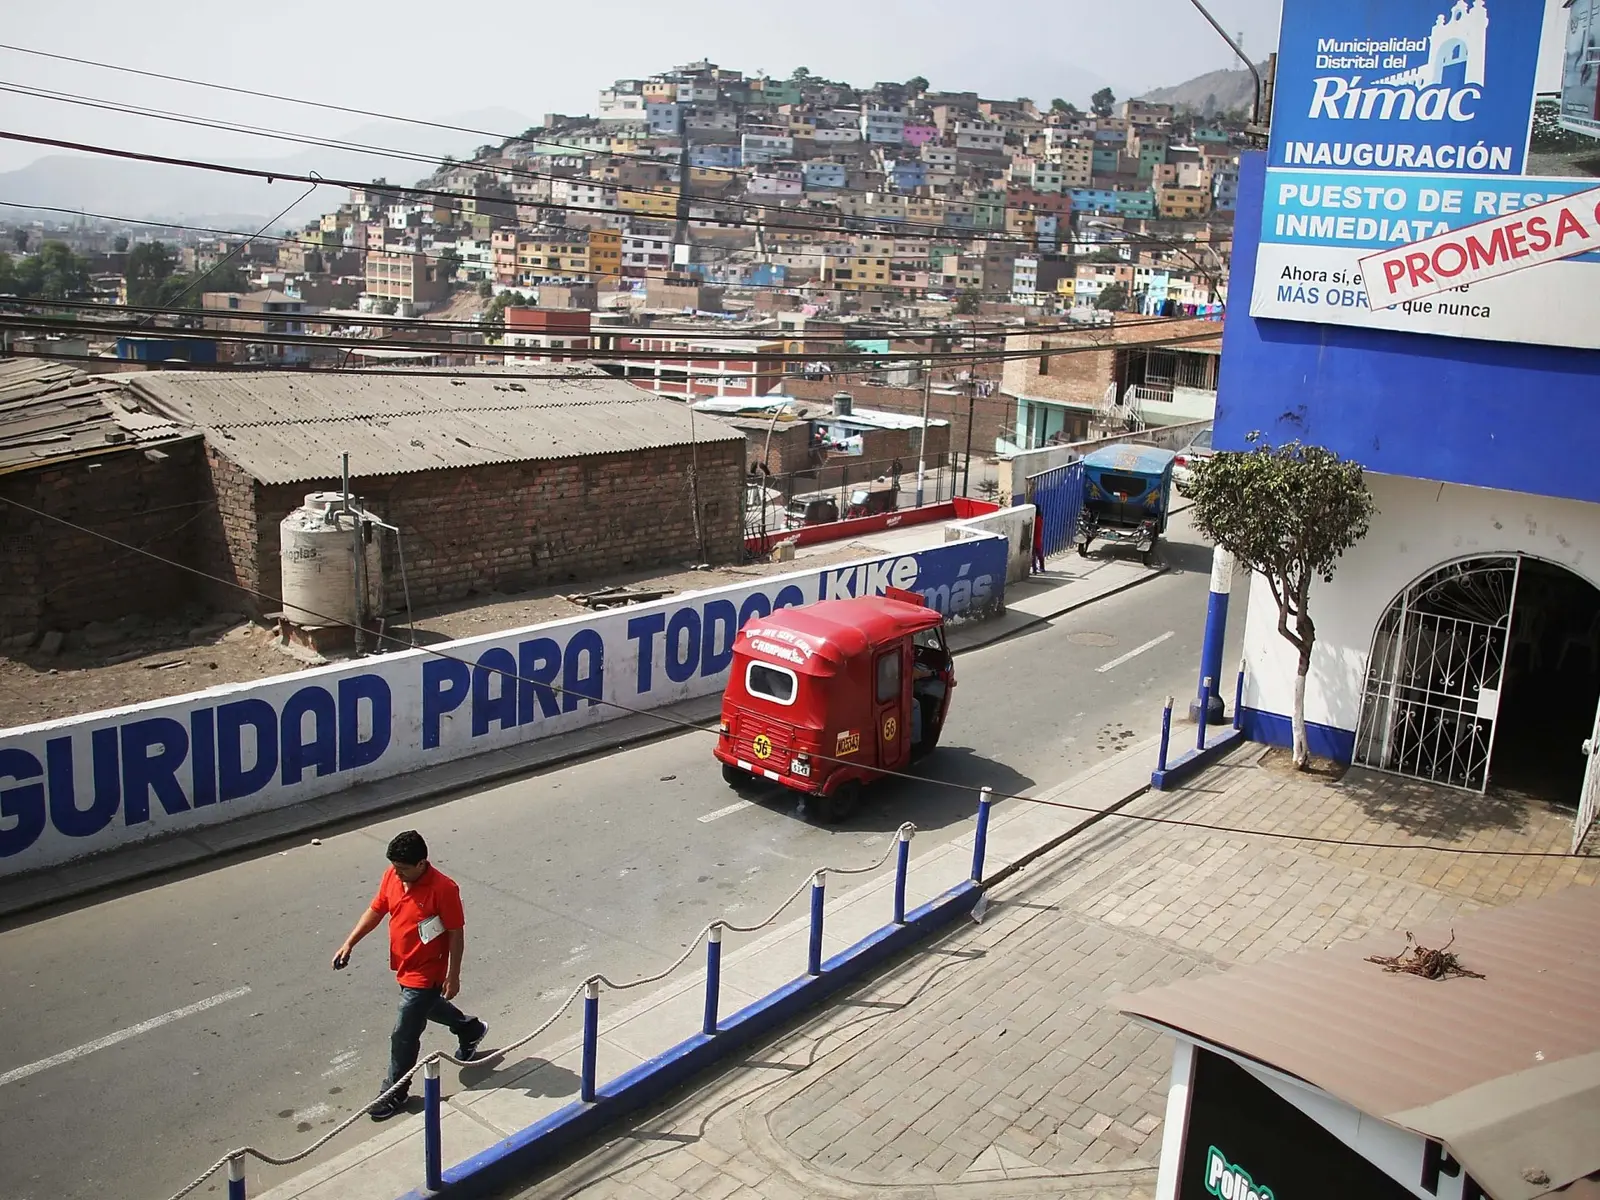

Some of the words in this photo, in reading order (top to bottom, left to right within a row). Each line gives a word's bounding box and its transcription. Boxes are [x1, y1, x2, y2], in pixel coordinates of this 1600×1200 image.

[1317, 38, 1426, 55] Municipalidad
[1316, 55, 1379, 70] Distrital
[1383, 56, 1407, 69] del
[1308, 76, 1481, 121] Rímac
[1284, 141, 1512, 170] INAUGURACIÓN
[1278, 184, 1407, 211] PUESTO
[1417, 189, 1463, 214] DE
[1473, 191, 1565, 215] RES
[1383, 208, 1590, 294] PROMESA
[1280, 266, 1327, 282] Ahora
[1332, 269, 1350, 286] sí,
[1277, 282, 1319, 304] MÁS
[1326, 289, 1398, 310] OBR
[1402, 300, 1432, 315] que
[1438, 302, 1491, 318] nunca
[422, 629, 604, 750] PARA
[627, 585, 804, 694] TOD
[885, 720, 896, 737] 56
[755, 738, 768, 756] 56
